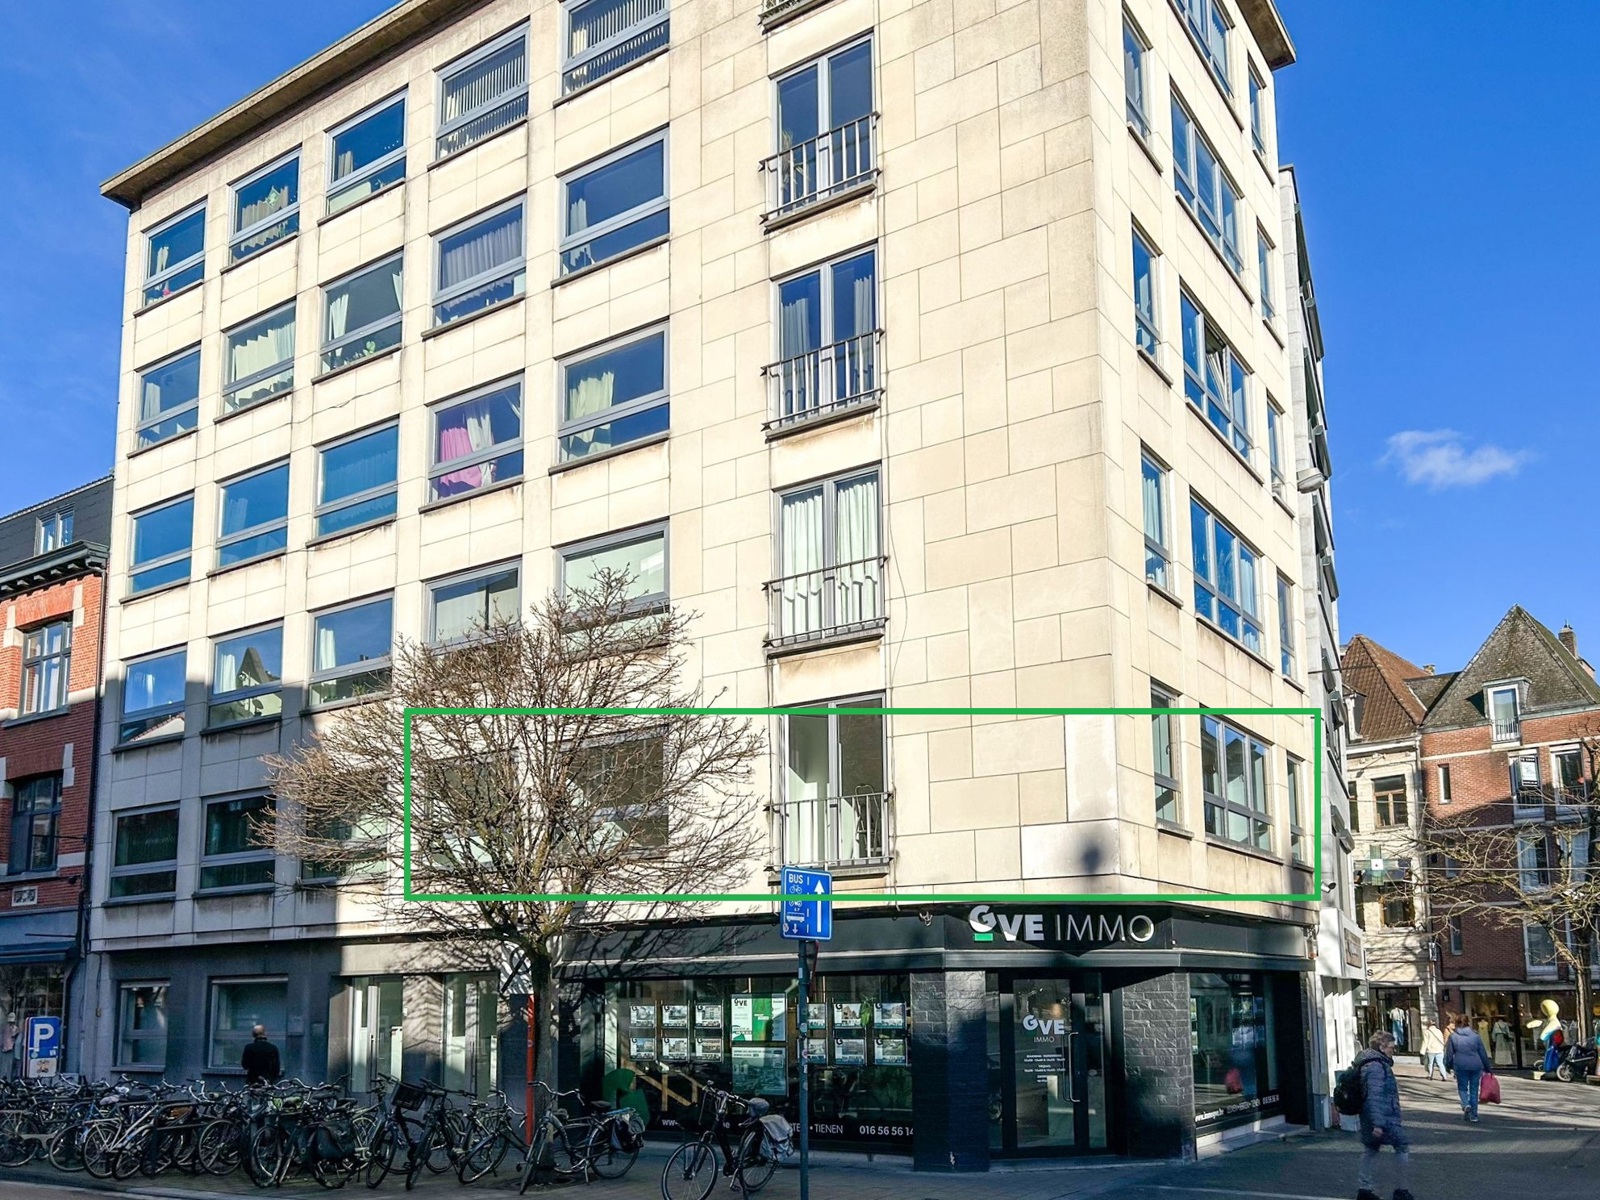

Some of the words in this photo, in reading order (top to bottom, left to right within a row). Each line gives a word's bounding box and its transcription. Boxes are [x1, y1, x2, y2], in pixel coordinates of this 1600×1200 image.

[788, 873, 803, 884] BUS
[969, 905, 1045, 941] GVE
[1055, 914, 1155, 942] IMMO
[1023, 1014, 1065, 1035] GVE
[33, 1023, 54, 1052] P
[814, 1123, 843, 1134] TIENEN
[859, 1125, 876, 1135] 016
[877, 1126, 889, 1136] 56
[891, 1126, 903, 1136] 56
